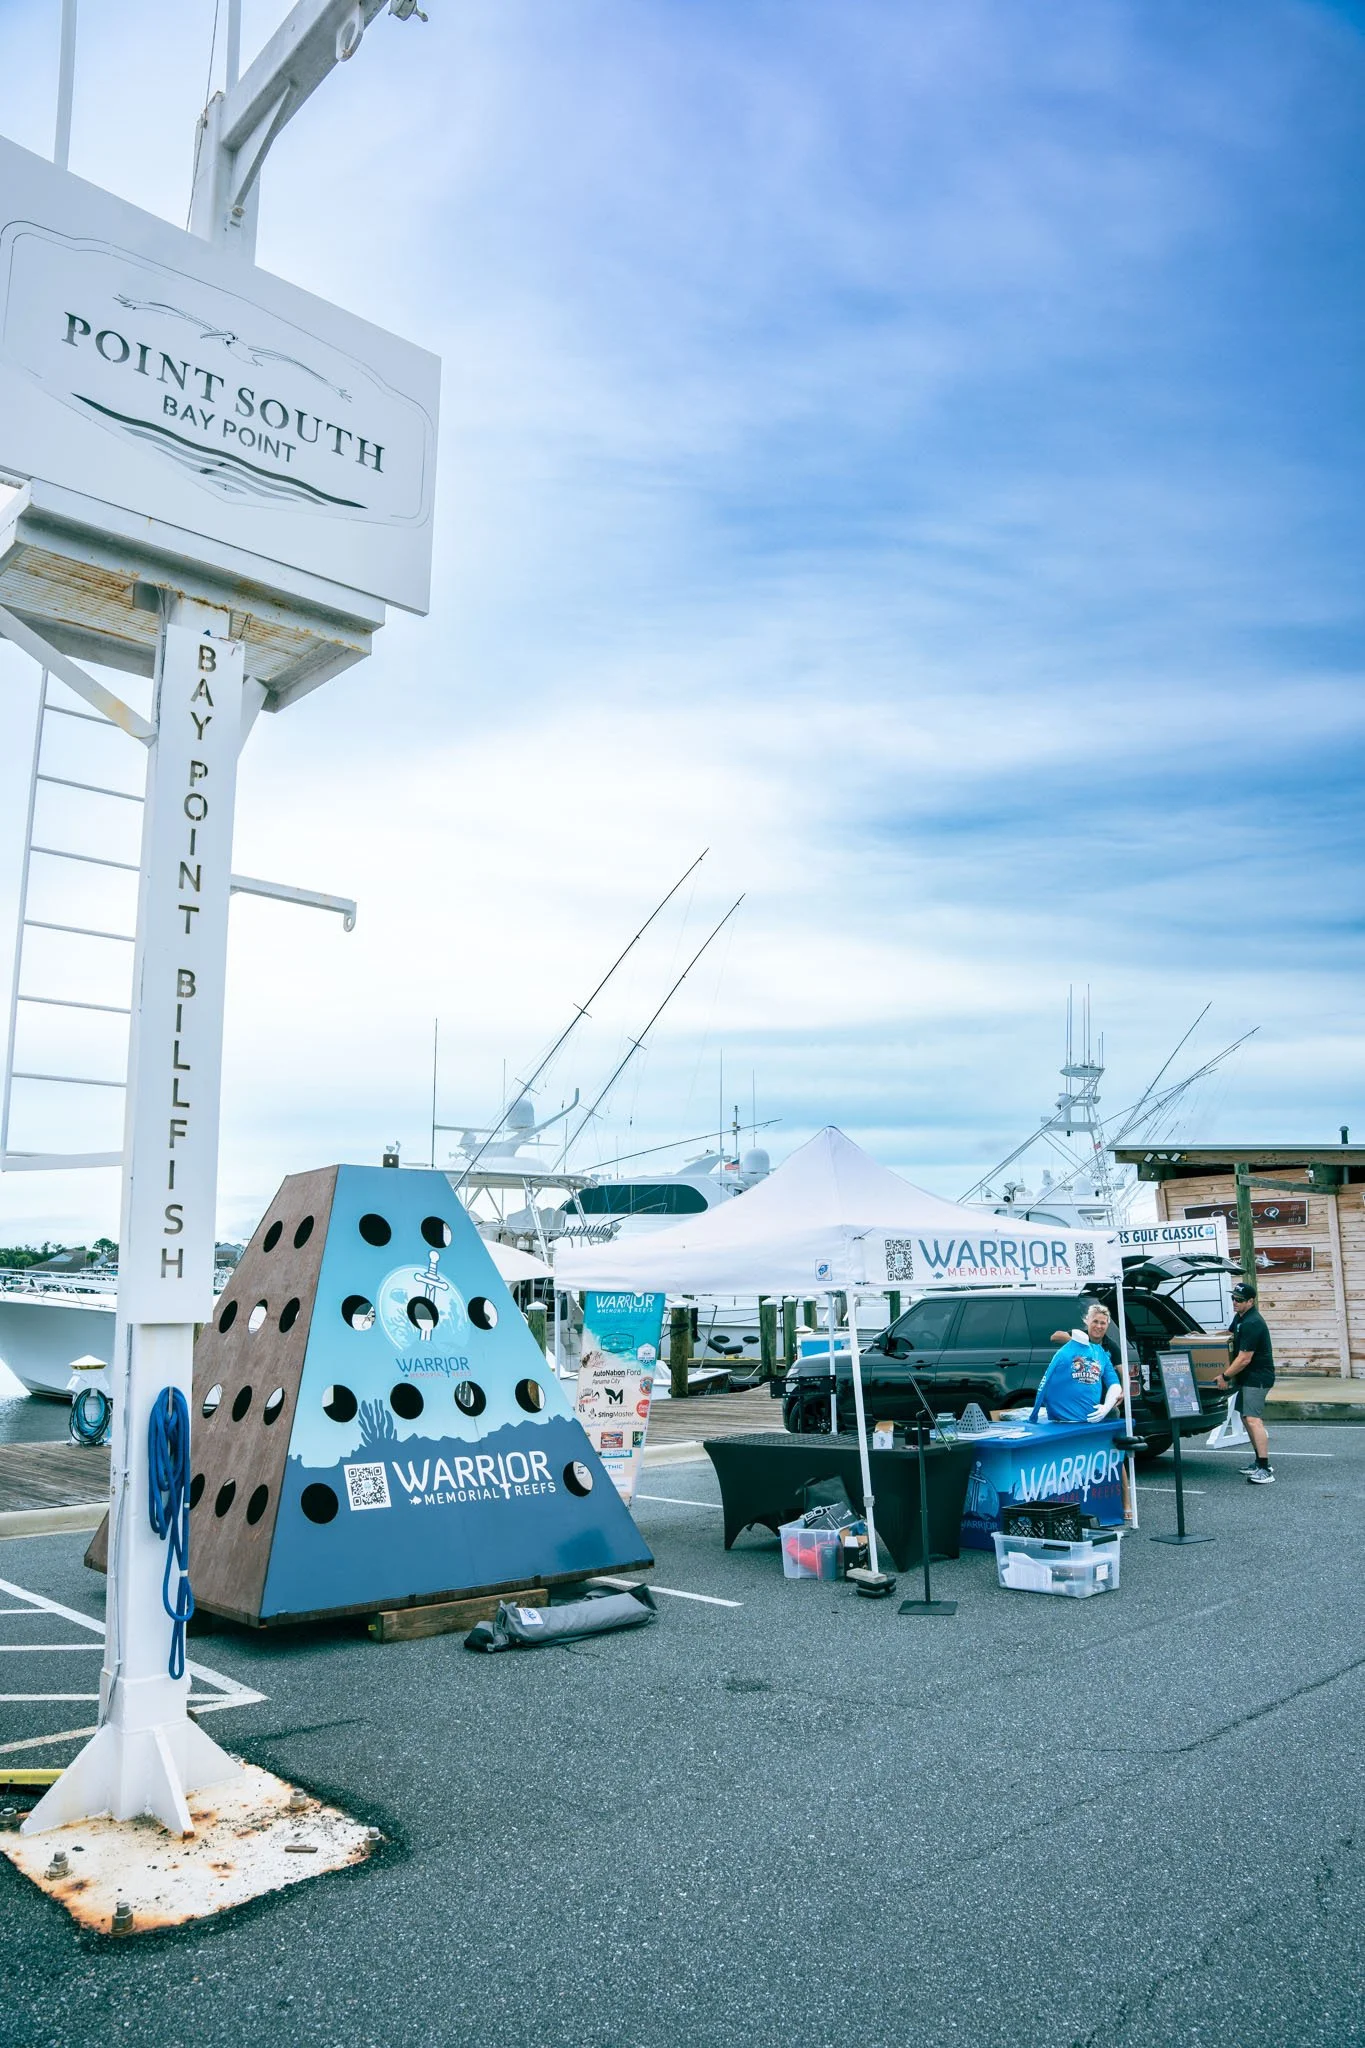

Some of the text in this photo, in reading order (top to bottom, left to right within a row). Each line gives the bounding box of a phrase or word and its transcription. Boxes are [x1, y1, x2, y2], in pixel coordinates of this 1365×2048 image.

[61, 311, 386, 474] POINT SOUTH
[163, 395, 297, 463] BAY POINT
[160, 644, 217, 1279] BAY POINT BILLFISH
[1133, 1229, 1159, 1243] GULF
[1162, 1226, 1205, 1241] CLASSIC
[918, 1239, 1070, 1271] WARRIOR
[947, 1266, 1072, 1277] MEMORIAL REEFS
[596, 1294, 655, 1309] WARRIOR
[395, 1356, 470, 1373] WARRIOR
[592, 1368, 642, 1378] AutoNation Ford
[392, 1450, 553, 1495] WARRIOR
[1020, 1449, 1120, 1503] WARRIOR
[424, 1482, 557, 1506] MEMORIAL REEFS
[1091, 1484, 1121, 1497] REEFS
